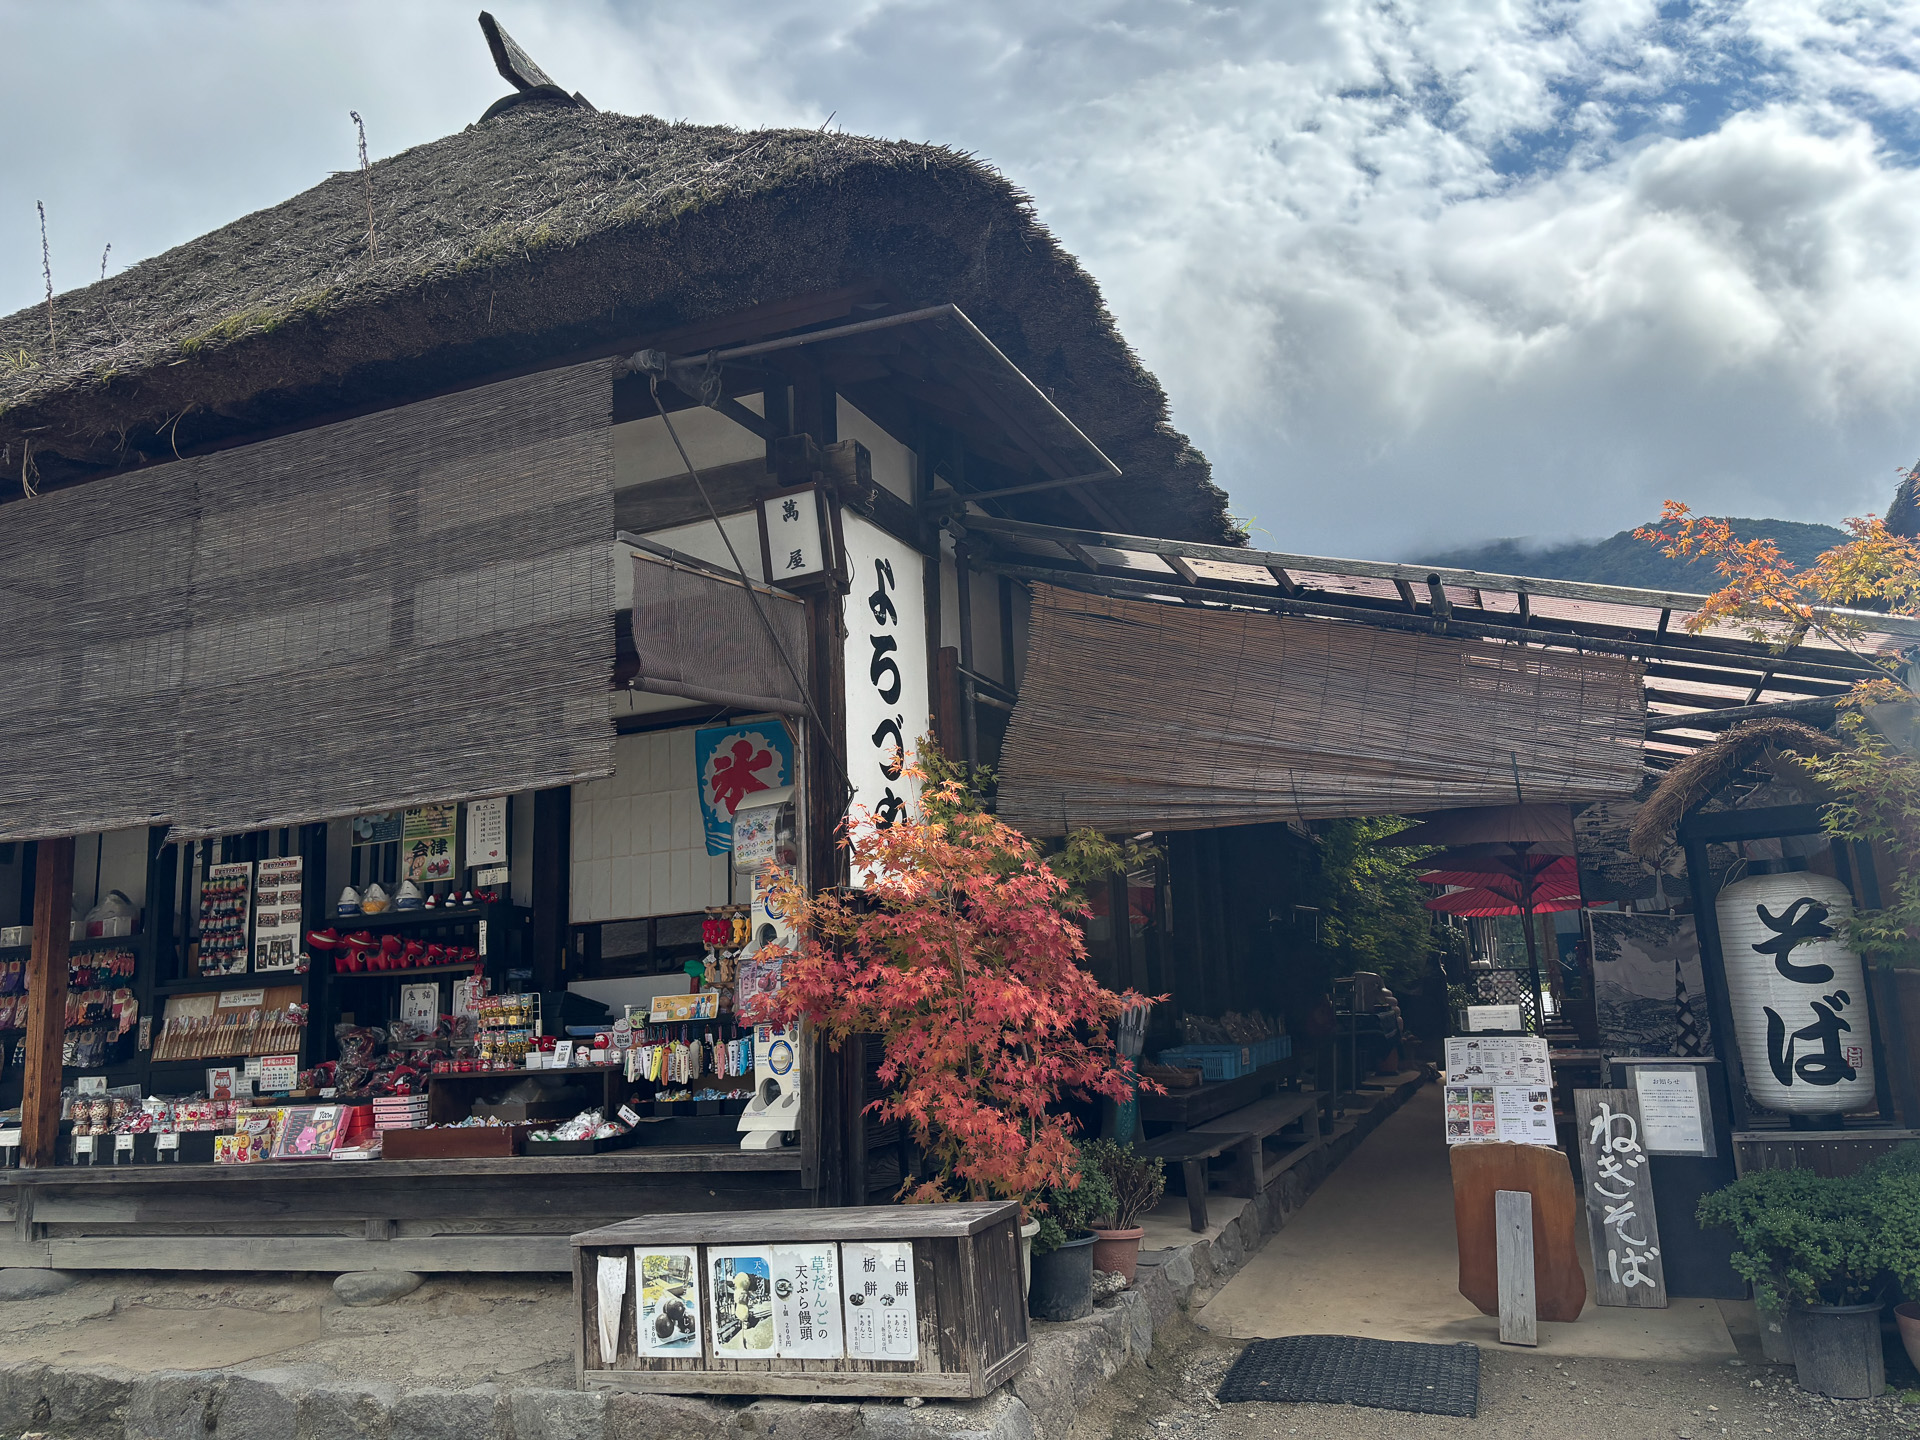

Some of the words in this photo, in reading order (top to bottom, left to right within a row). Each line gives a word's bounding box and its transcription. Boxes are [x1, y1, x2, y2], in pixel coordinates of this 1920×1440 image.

[782, 500, 806, 570] 萬屋
[711, 739, 772, 815] 氷
[411, 837, 449, 858] 会津
[1752, 897, 1856, 1086] そば
[1590, 1102, 1661, 1288] ねぎそば
[795, 1265, 813, 1341] 天ぷら饅頭
[811, 1255, 829, 1339] 草だんごの
[826, 1249, 834, 1288] 萬屋おすすめ
[862, 1257, 878, 1297] 栃餅
[894, 1257, 909, 1297] 白餅
